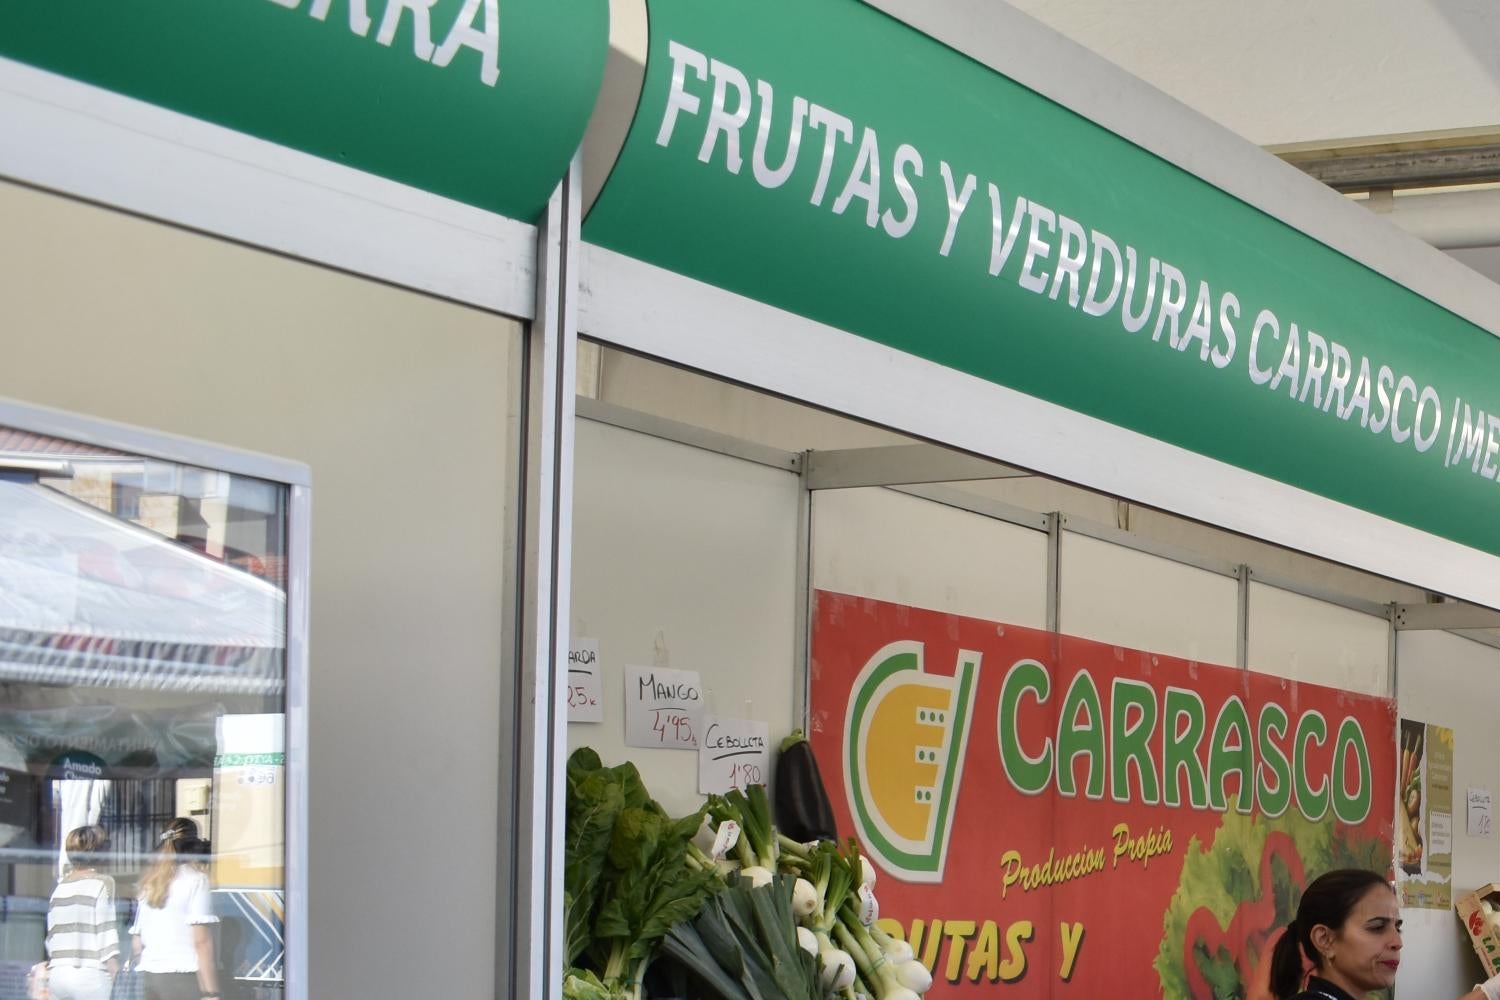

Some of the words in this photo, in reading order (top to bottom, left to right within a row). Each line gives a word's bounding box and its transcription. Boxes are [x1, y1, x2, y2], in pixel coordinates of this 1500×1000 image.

[656, 40, 923, 238] FRUTAS
[939, 160, 977, 257] Y
[989, 182, 1240, 369] VERDURAS
[1248, 309, 1441, 452] CARRASCO
[639, 673, 699, 700] MANGO
[998, 659, 1372, 823] CARRASCO
[1001, 846, 1106, 898] Produccion
[1112, 822, 1173, 868] Propia
[1059, 921, 1084, 979] Y
